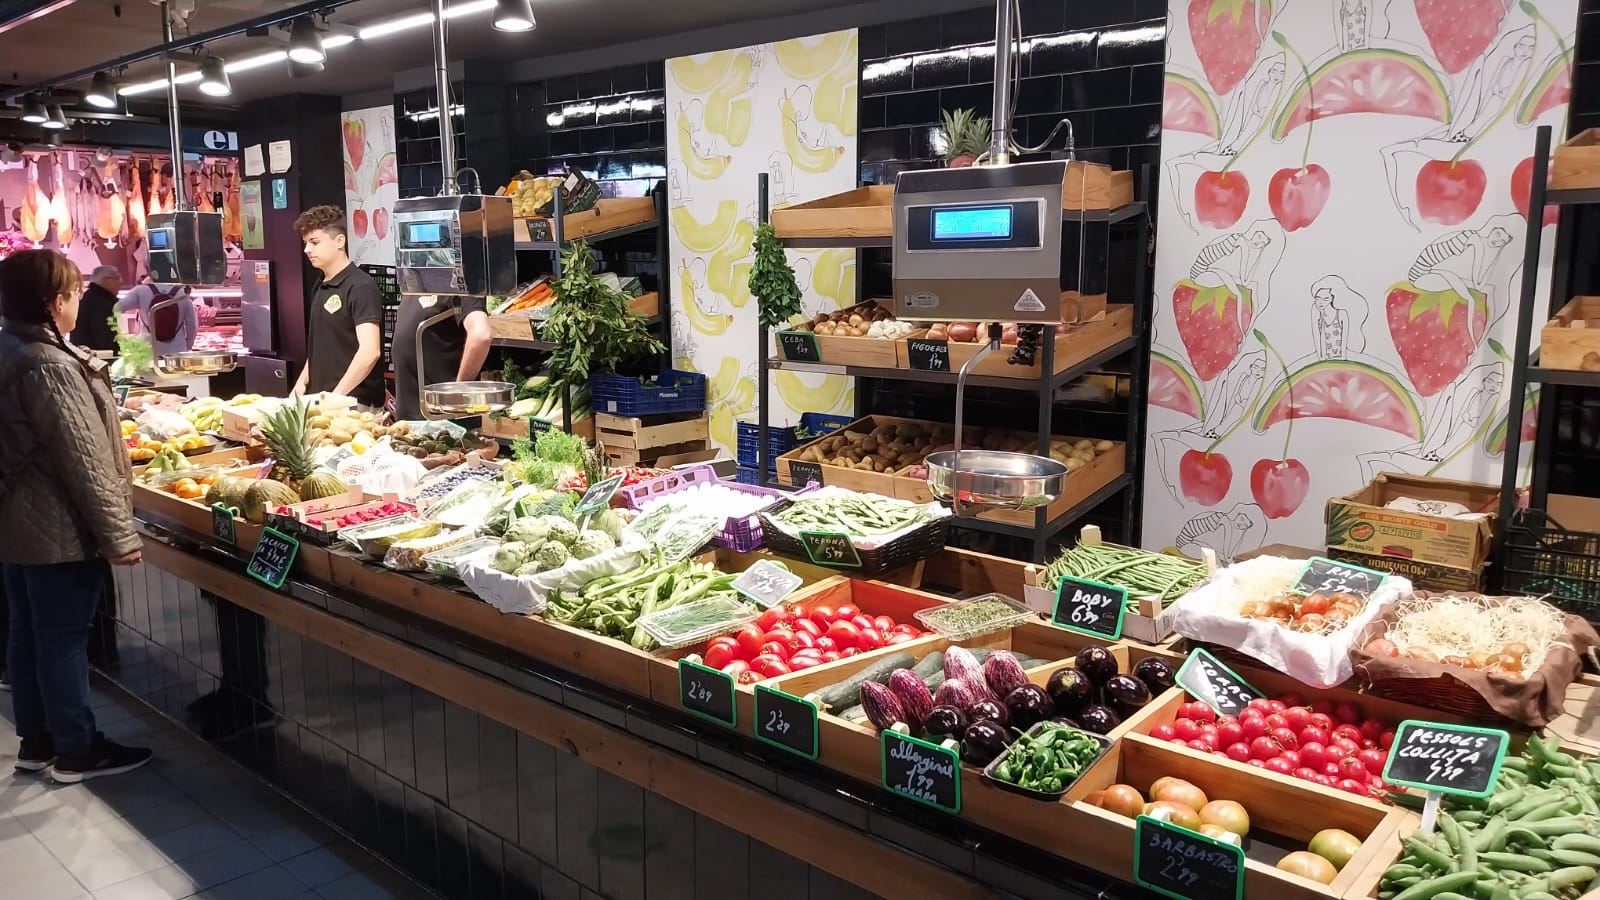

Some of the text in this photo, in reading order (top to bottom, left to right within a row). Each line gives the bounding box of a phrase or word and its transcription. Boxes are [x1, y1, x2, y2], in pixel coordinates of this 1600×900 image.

[1364, 512, 1438, 528] DEL MONTE GOLD
[1326, 566, 1364, 579] RAF
[1367, 559, 1428, 576] HONEYGLOW
[1071, 589, 1113, 608] BOBY
[1071, 604, 1100, 625] 6'99
[688, 680, 712, 703] 2'89
[1201, 661, 1253, 706] TOMAC
[765, 709, 790, 734] 2'29
[1407, 729, 1488, 748] PESSOLS
[1399, 745, 1480, 764] LOLLITA
[1149, 832, 1237, 873] BARBASTRO
[1159, 855, 1199, 886] 2'99
